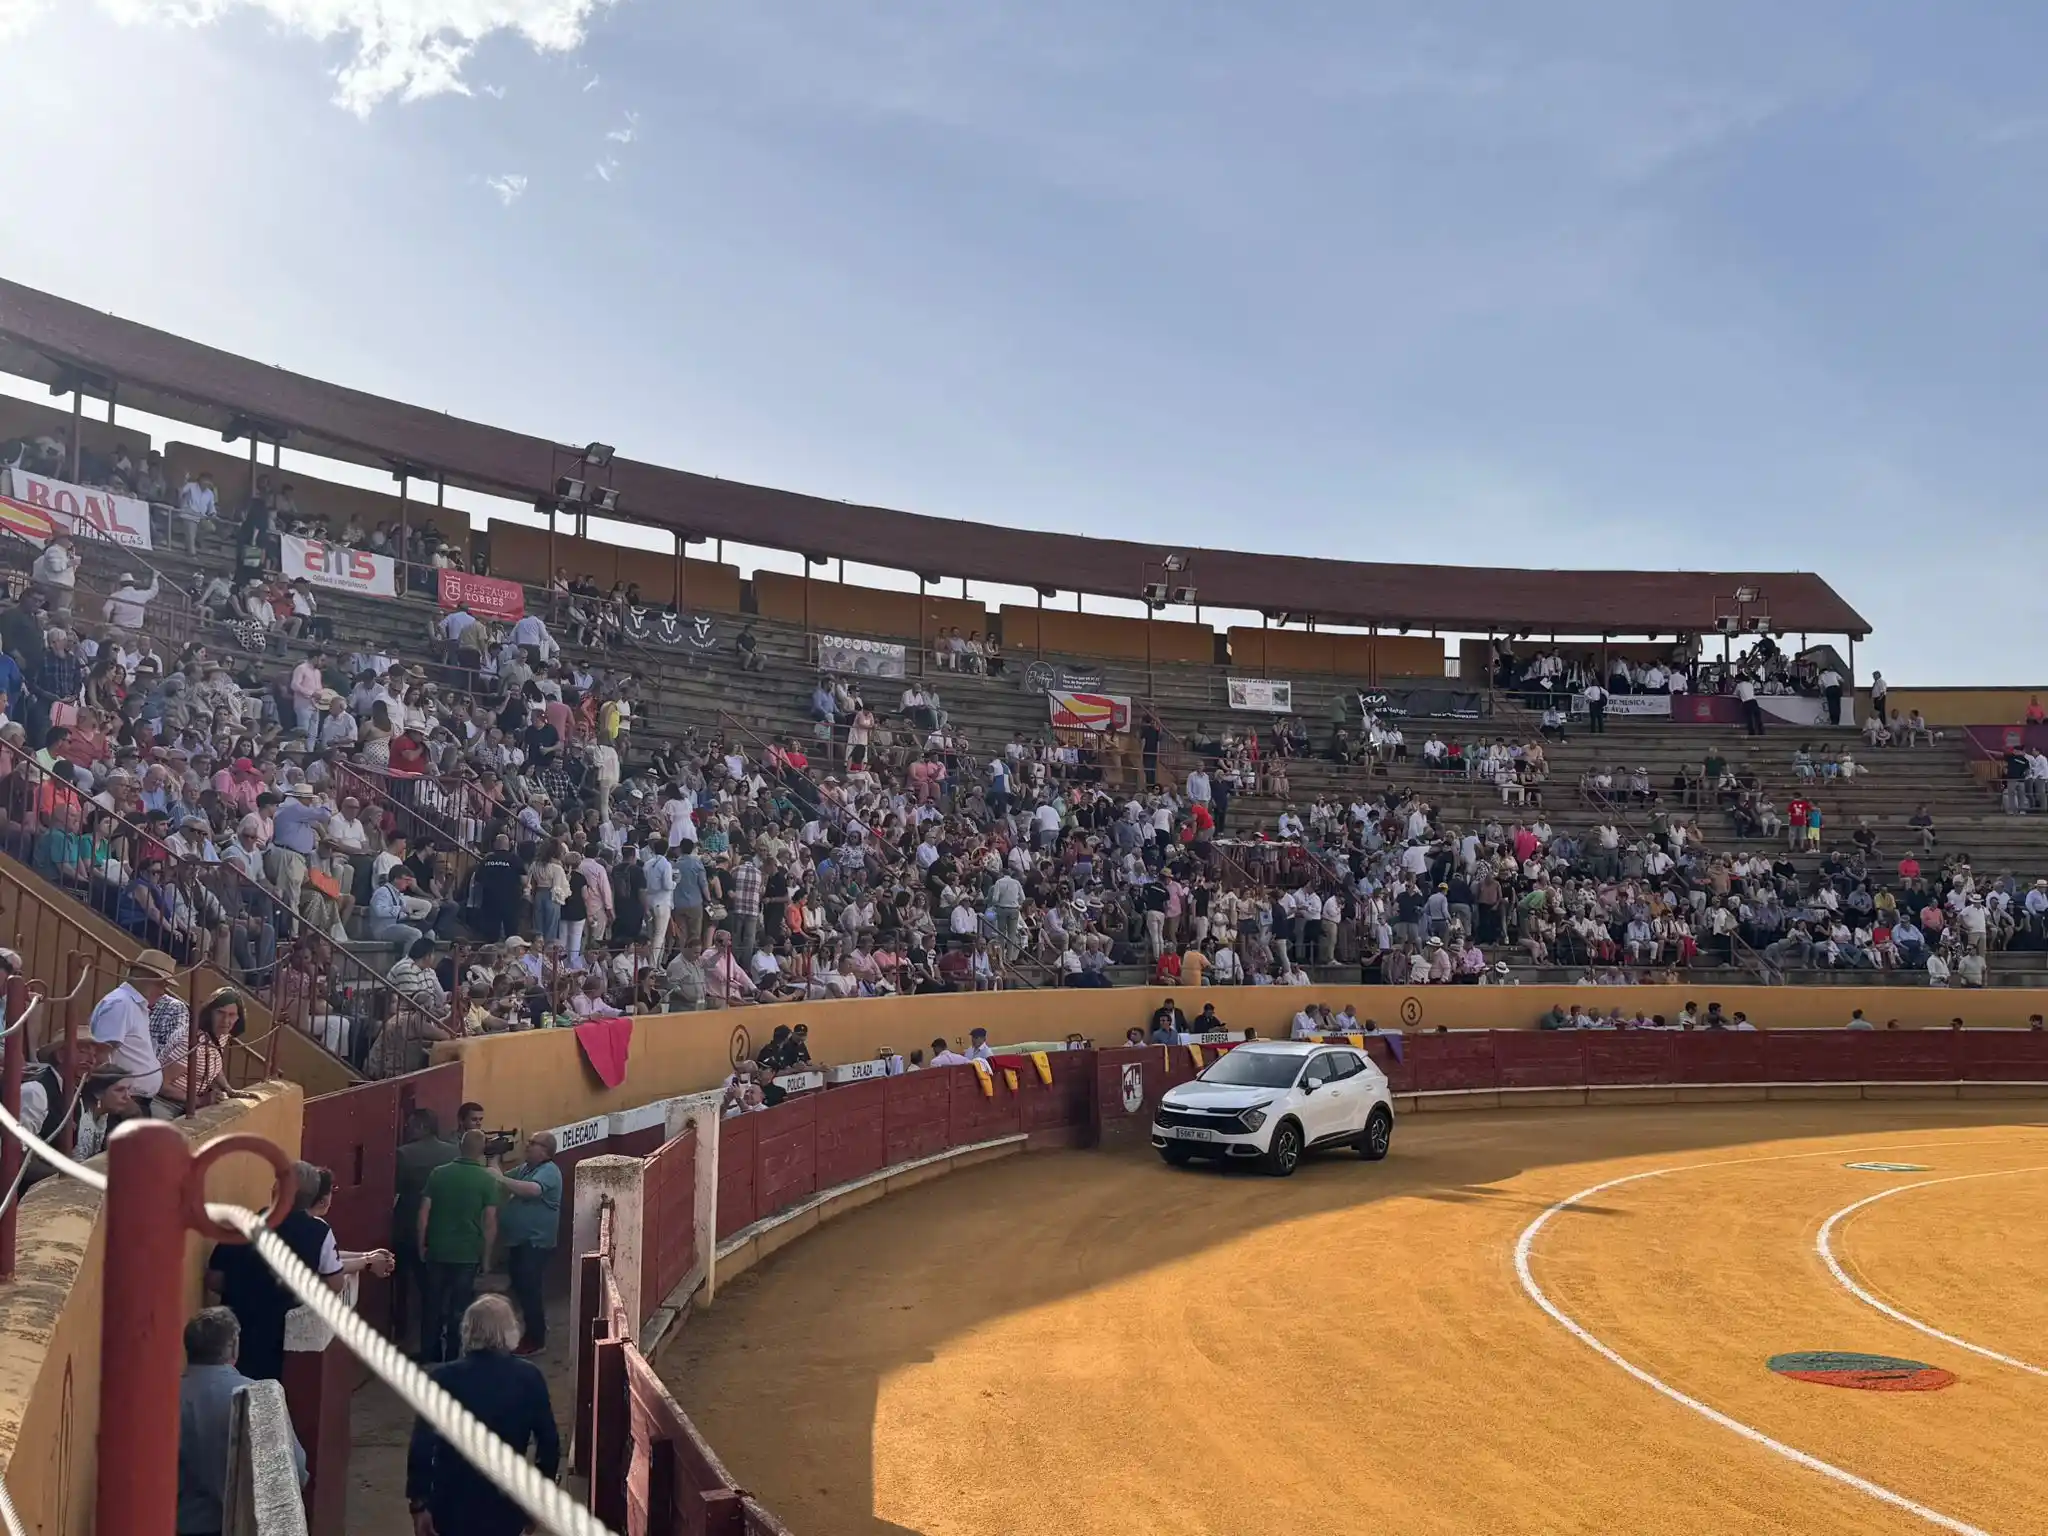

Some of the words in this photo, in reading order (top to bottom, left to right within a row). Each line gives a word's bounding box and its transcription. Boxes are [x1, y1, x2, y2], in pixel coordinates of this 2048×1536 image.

[27, 478, 139, 535] ROAL
[464, 583, 518, 600] GESTAURO
[464, 592, 504, 608] TORRES
[1407, 1003, 1416, 1020] 3
[1201, 1033, 1229, 1044] EMPRESA
[735, 1034, 745, 1061] 2
[562, 1122, 599, 1149] DELEGADO
